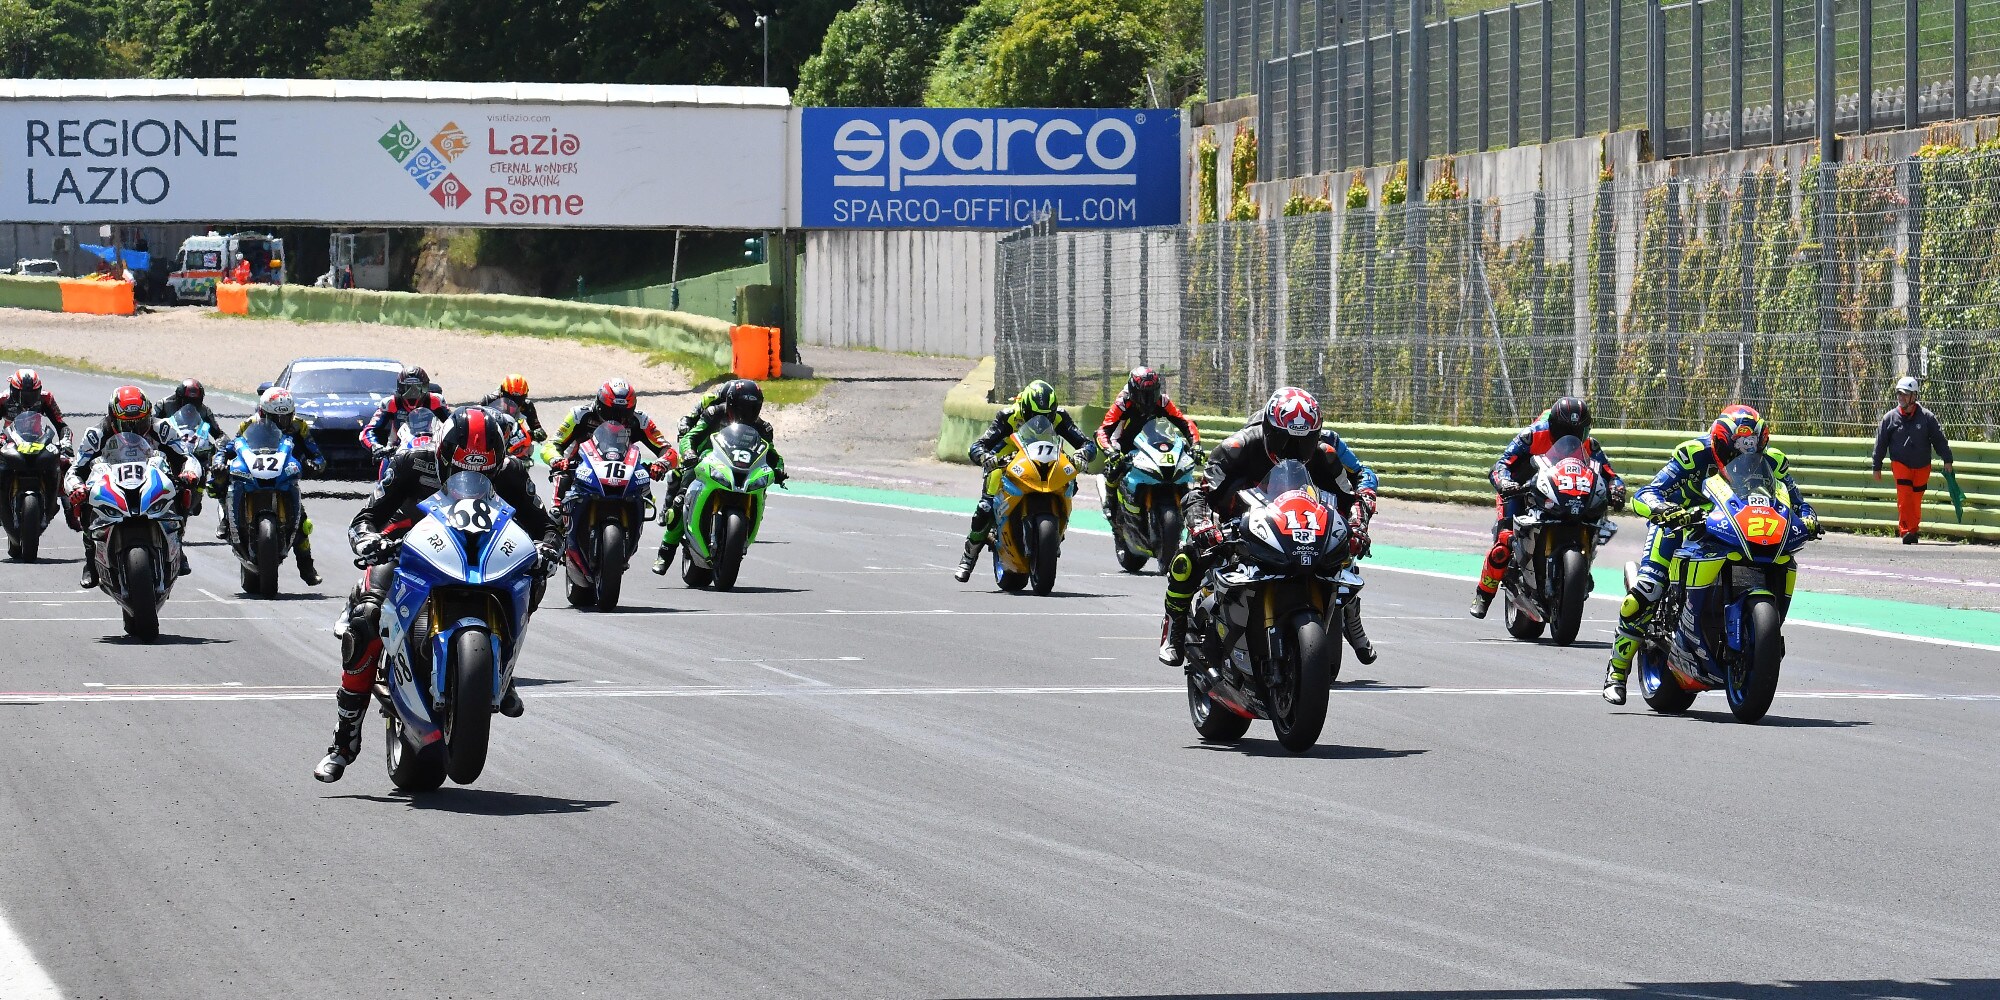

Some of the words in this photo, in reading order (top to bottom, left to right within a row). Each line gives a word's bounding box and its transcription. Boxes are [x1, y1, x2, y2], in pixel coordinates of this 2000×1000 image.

[487, 113, 551, 122] visitlazio.com
[27, 119, 237, 157] REGIONE
[488, 127, 580, 156] Lazio
[833, 117, 1137, 191] sparco
[489, 162, 531, 174] ETERNAL
[535, 162, 578, 174] WONDERS
[27, 167, 170, 205] LAZIO
[507, 174, 560, 187] EMBRACING
[485, 187, 584, 216] Rome
[833, 197, 1137, 223] SPARCO-OFFICIAL.COM
[465, 454, 487, 465] Arai
[732, 449, 752, 463] 13
[1037, 444, 1054, 456] 17
[117, 464, 144, 483] 129
[252, 457, 279, 472] 42
[604, 462, 627, 479] 16
[1557, 475, 1590, 493] 32
[447, 498, 493, 530] 68
[1283, 511, 1321, 531] 11
[1747, 517, 1779, 537] 27
